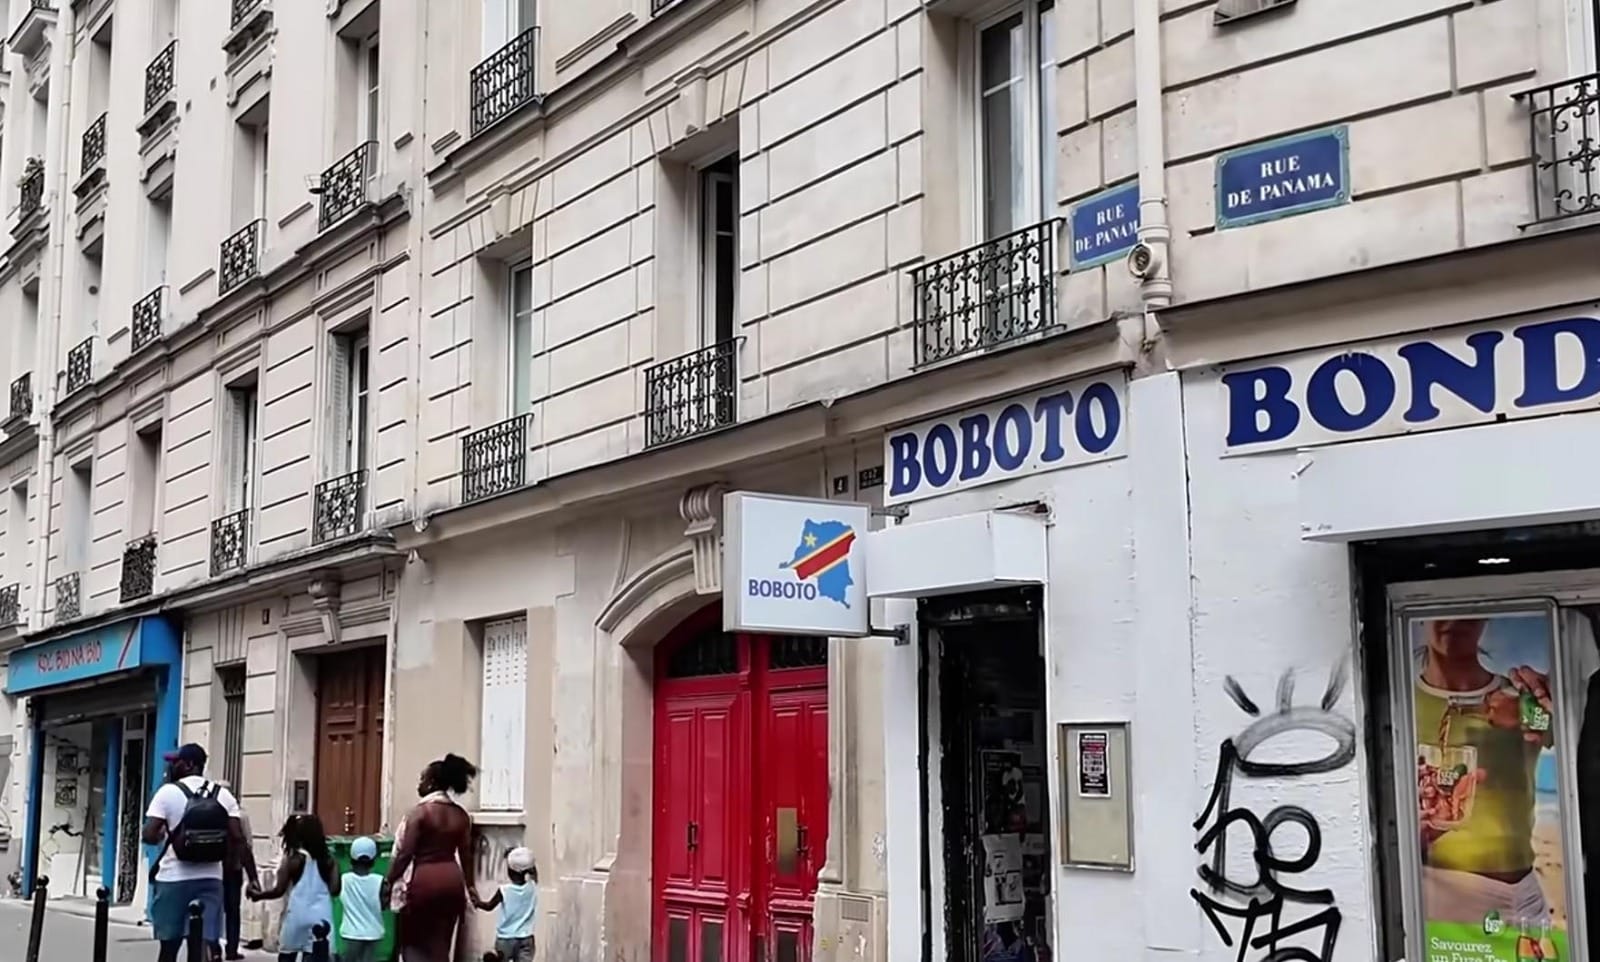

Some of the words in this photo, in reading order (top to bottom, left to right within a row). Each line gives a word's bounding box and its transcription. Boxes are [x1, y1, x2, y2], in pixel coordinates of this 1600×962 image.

[1261, 155, 1300, 178] RUE
[1227, 188, 1252, 208] DE
[1259, 172, 1335, 201] PANAMA
[1097, 203, 1125, 226] RUE
[1075, 235, 1093, 253] DE
[1096, 219, 1138, 247] PANAM
[889, 382, 1121, 497] BOBOTO
[748, 578, 817, 601] BOBOTO
[1431, 937, 1492, 953] Savourez
